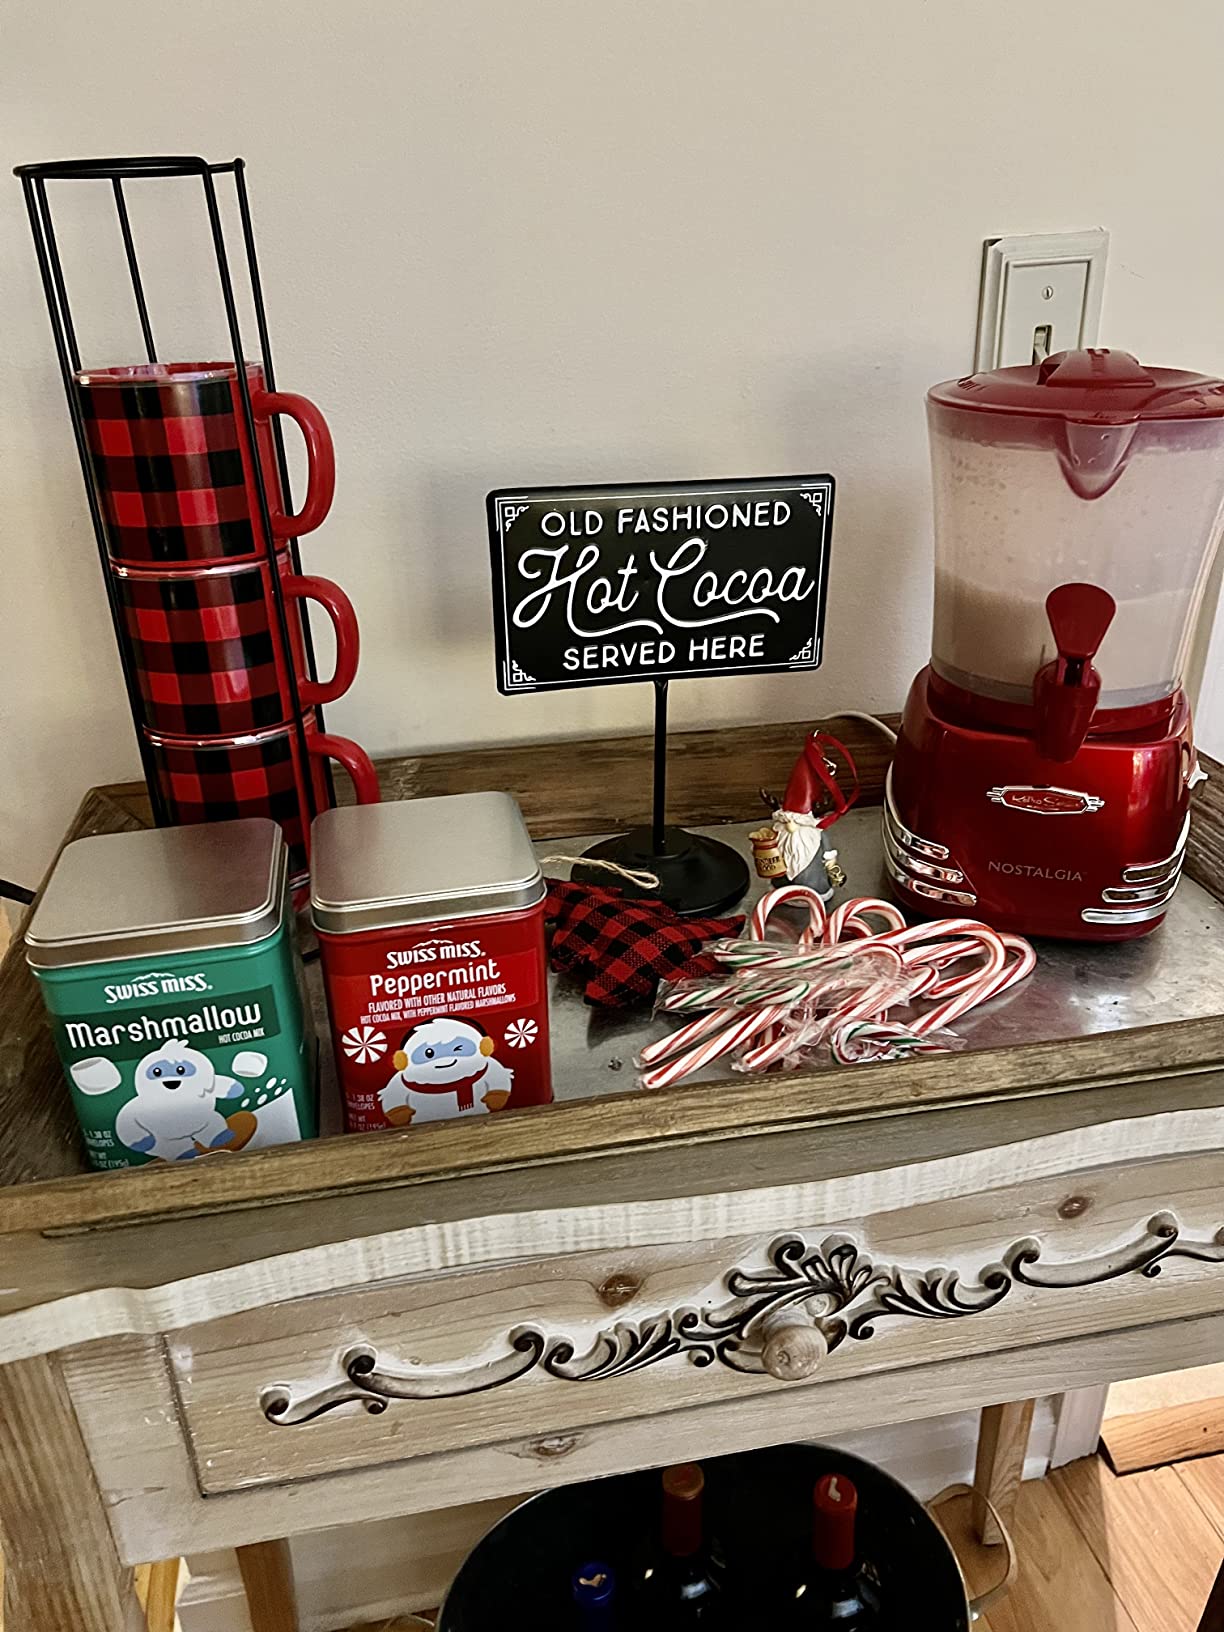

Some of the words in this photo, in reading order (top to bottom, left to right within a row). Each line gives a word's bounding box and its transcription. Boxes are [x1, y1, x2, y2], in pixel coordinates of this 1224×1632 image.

[541, 510, 603, 537] OLD
[617, 501, 791, 534] FASHIONED
[512, 544, 663, 637] Hot
[650, 537, 815, 627] Cocoa
[563, 641, 676, 671] SERVED
[689, 634, 765, 661] HERE
[988, 861, 1082, 881] NOSTALGIA
[370, 958, 501, 997] Peppermint
[368, 999, 403, 1013] FLAVORED
[404, 996, 422, 1008] WITH
[423, 993, 446, 1006] OTHER
[447, 988, 476, 1002] NATURAL
[478, 983, 507, 998] FLAVORS
[65, 1003, 262, 1049] Marshmallow
[218, 1033, 231, 1044] HOT
[232, 1030, 252, 1042] COCOA
[253, 1027, 265, 1038] MIX
